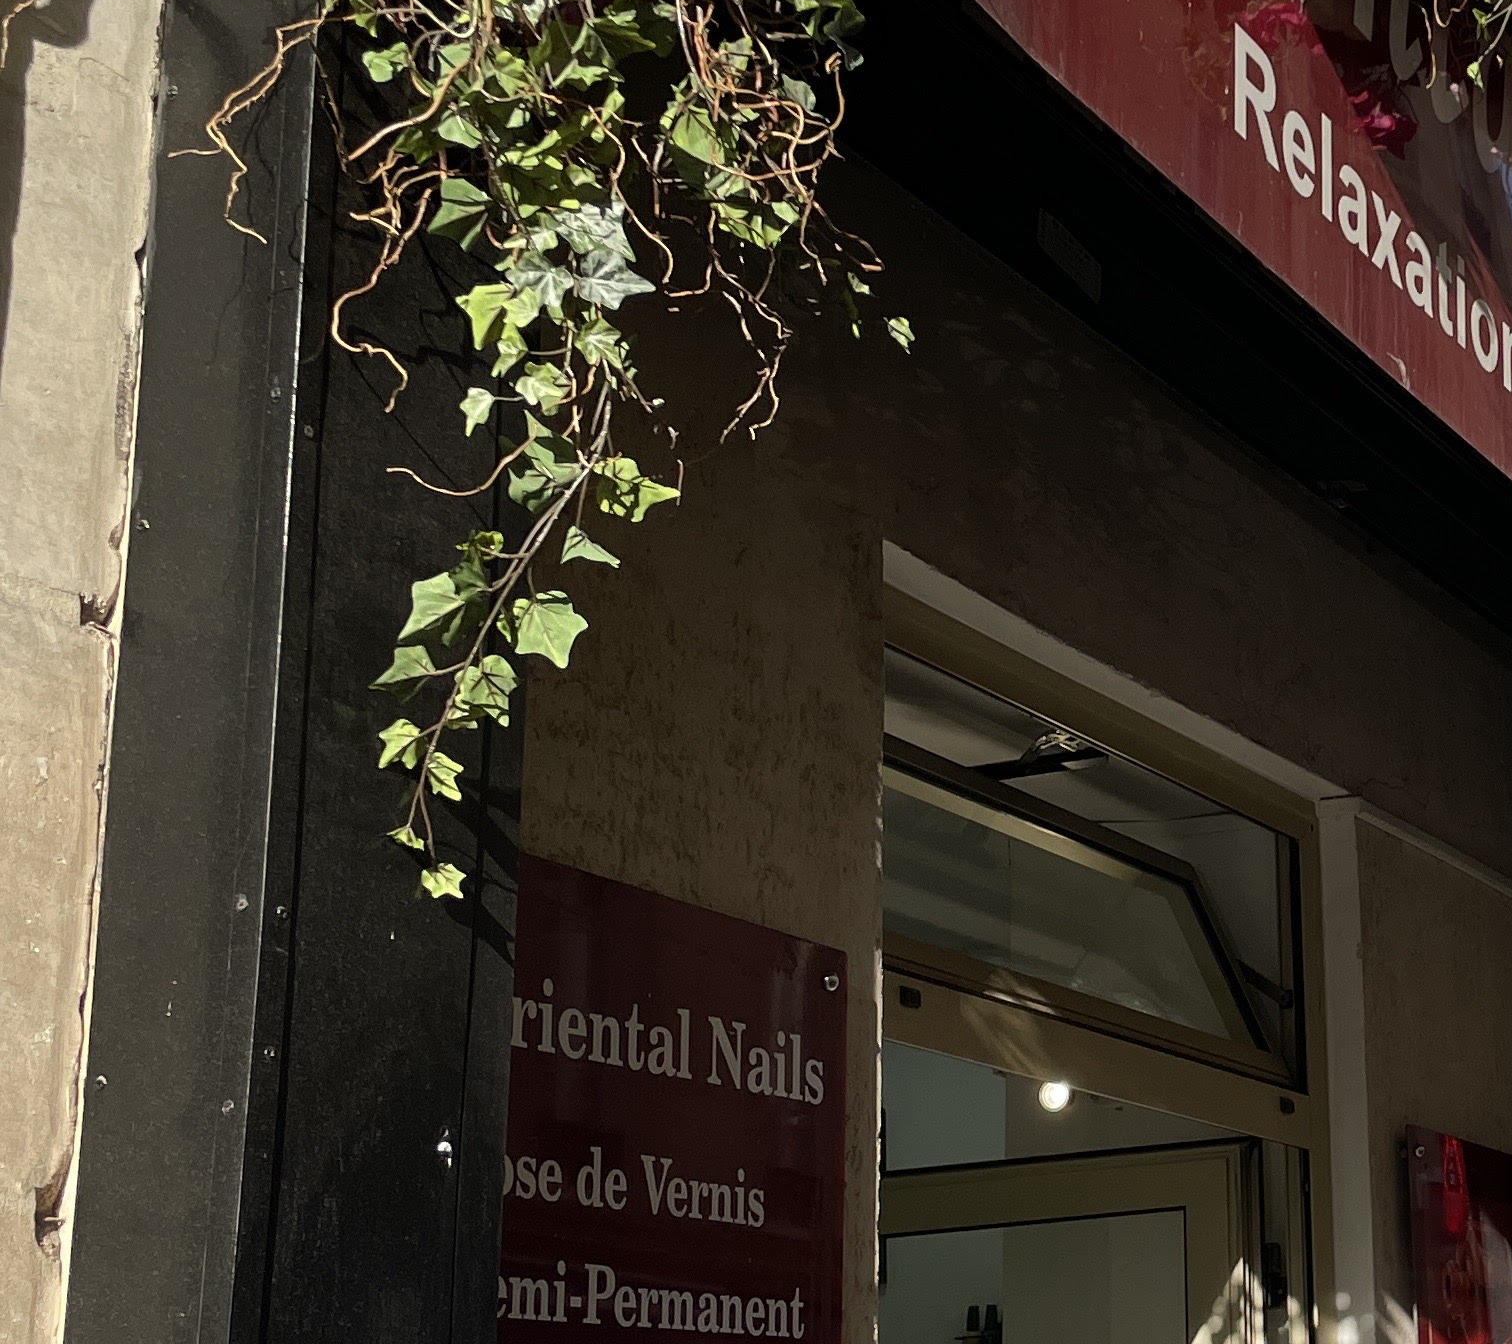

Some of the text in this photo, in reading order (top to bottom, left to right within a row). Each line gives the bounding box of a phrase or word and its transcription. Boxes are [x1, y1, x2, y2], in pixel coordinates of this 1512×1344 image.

[510, 978, 824, 1105] riental Nails
[502, 1147, 765, 1227] ose de Vernis
[496, 1261, 805, 1338] emi-Permanent
